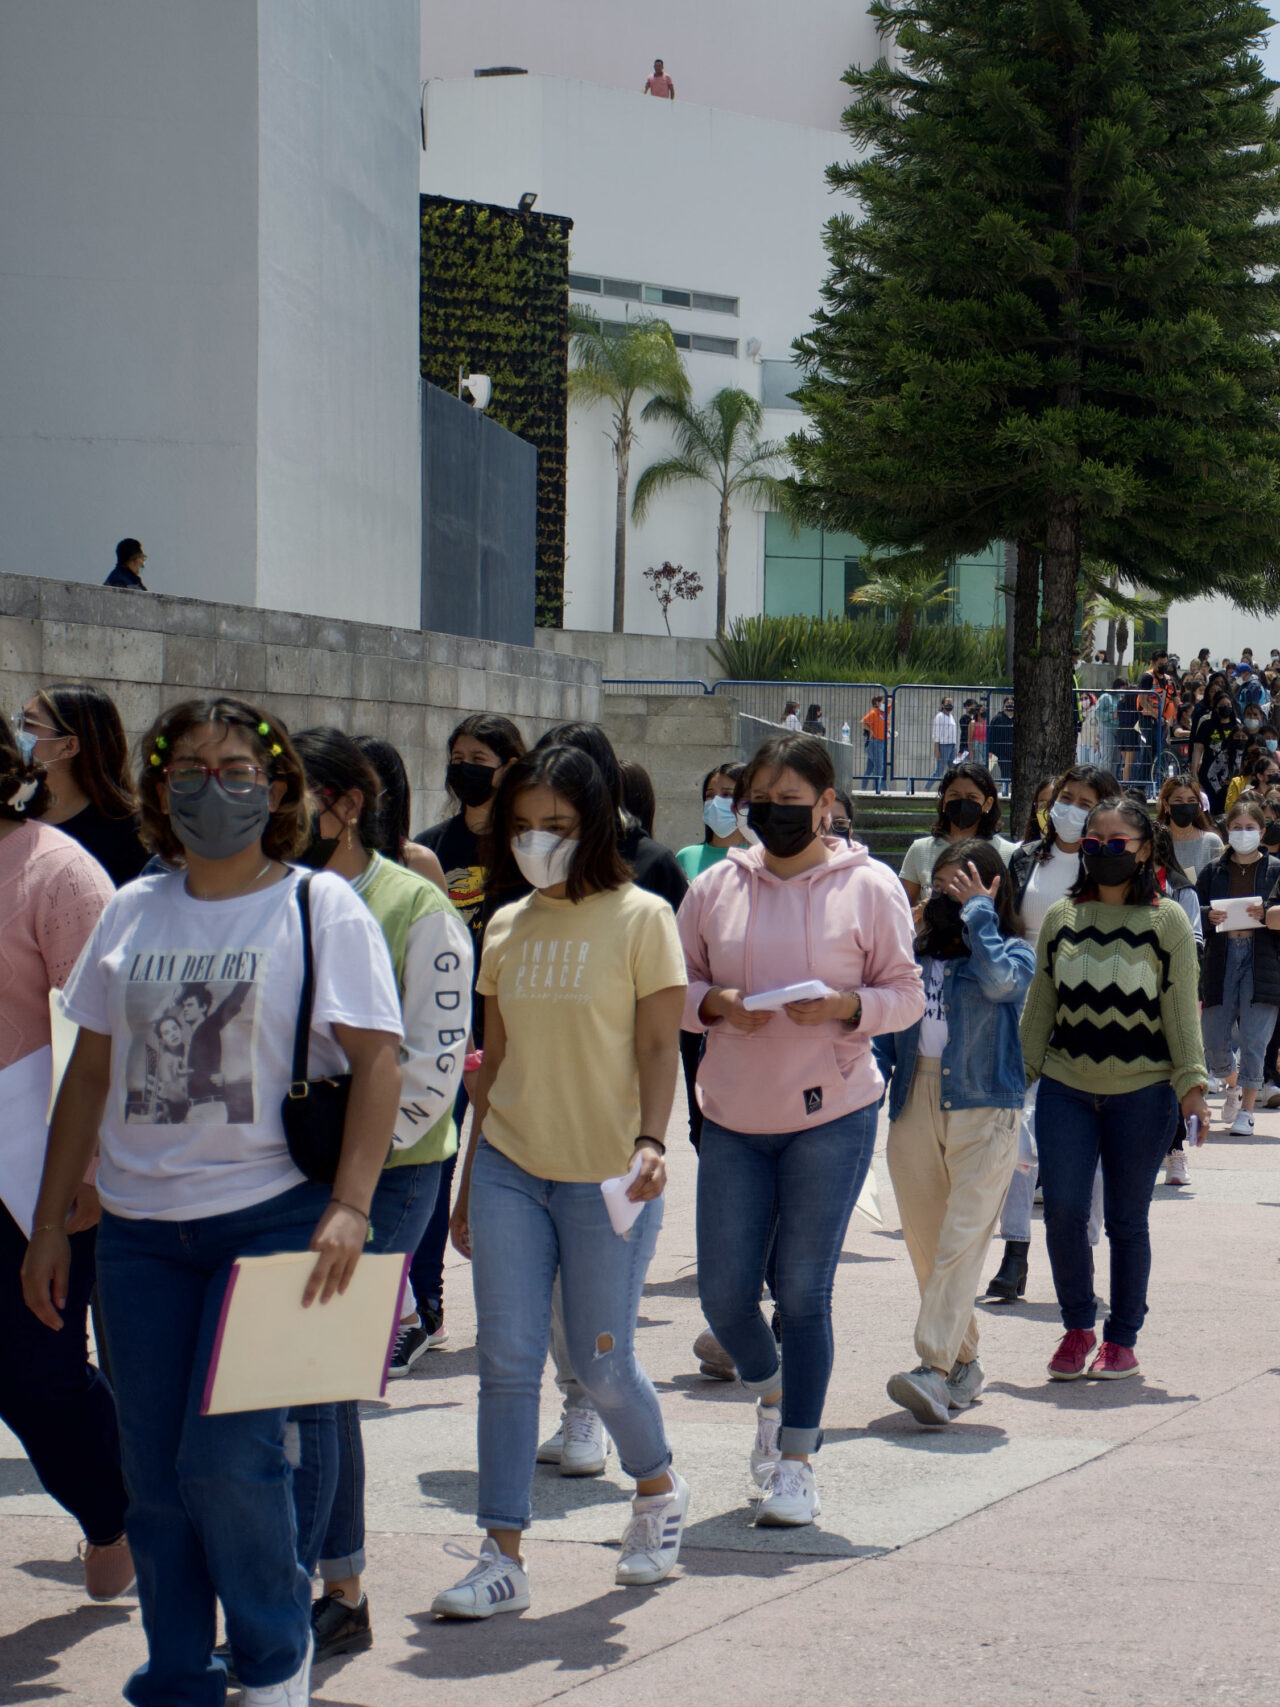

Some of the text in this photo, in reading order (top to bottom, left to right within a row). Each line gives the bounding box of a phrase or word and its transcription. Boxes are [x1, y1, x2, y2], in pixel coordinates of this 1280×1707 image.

[522, 940, 590, 963] INNER
[129, 951, 263, 981] LANA DEL REY
[515, 965, 585, 988] PEACE
